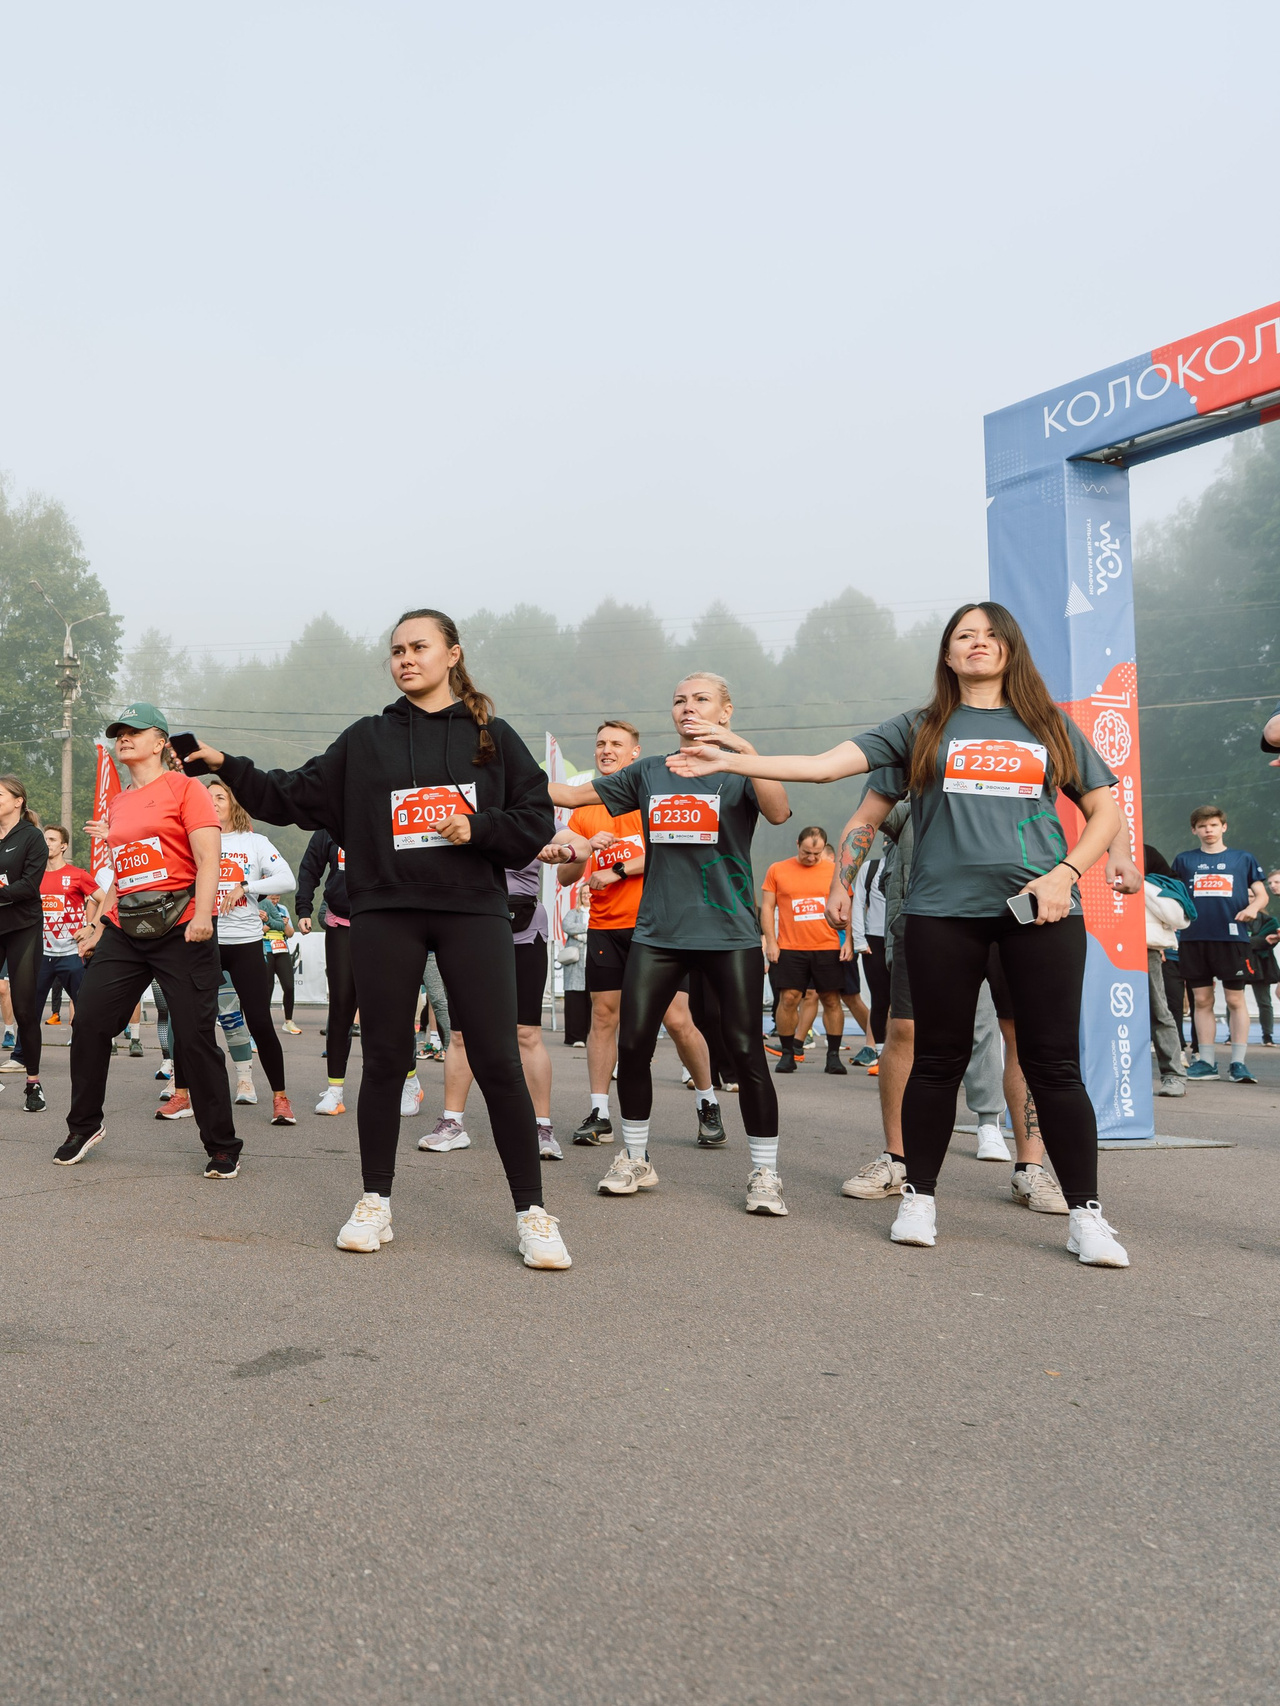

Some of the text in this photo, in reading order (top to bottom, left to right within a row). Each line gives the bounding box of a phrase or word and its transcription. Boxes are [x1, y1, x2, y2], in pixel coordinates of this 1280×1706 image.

[1086, 518, 1094, 556] ТУЛЬСКИЙ
[970, 754, 1022, 773] 2329
[412, 804, 457, 823] 2037
[663, 809, 701, 823] 2330
[1122, 775, 1136, 863] ЭВОКО
[122, 853, 149, 870] 2180
[605, 848, 632, 864] 2146
[220, 867, 234, 877] 127
[1202, 880, 1224, 888] 2229
[801, 904, 818, 912] 2121
[1117, 1024, 1135, 1118] ЭВОКОМ
